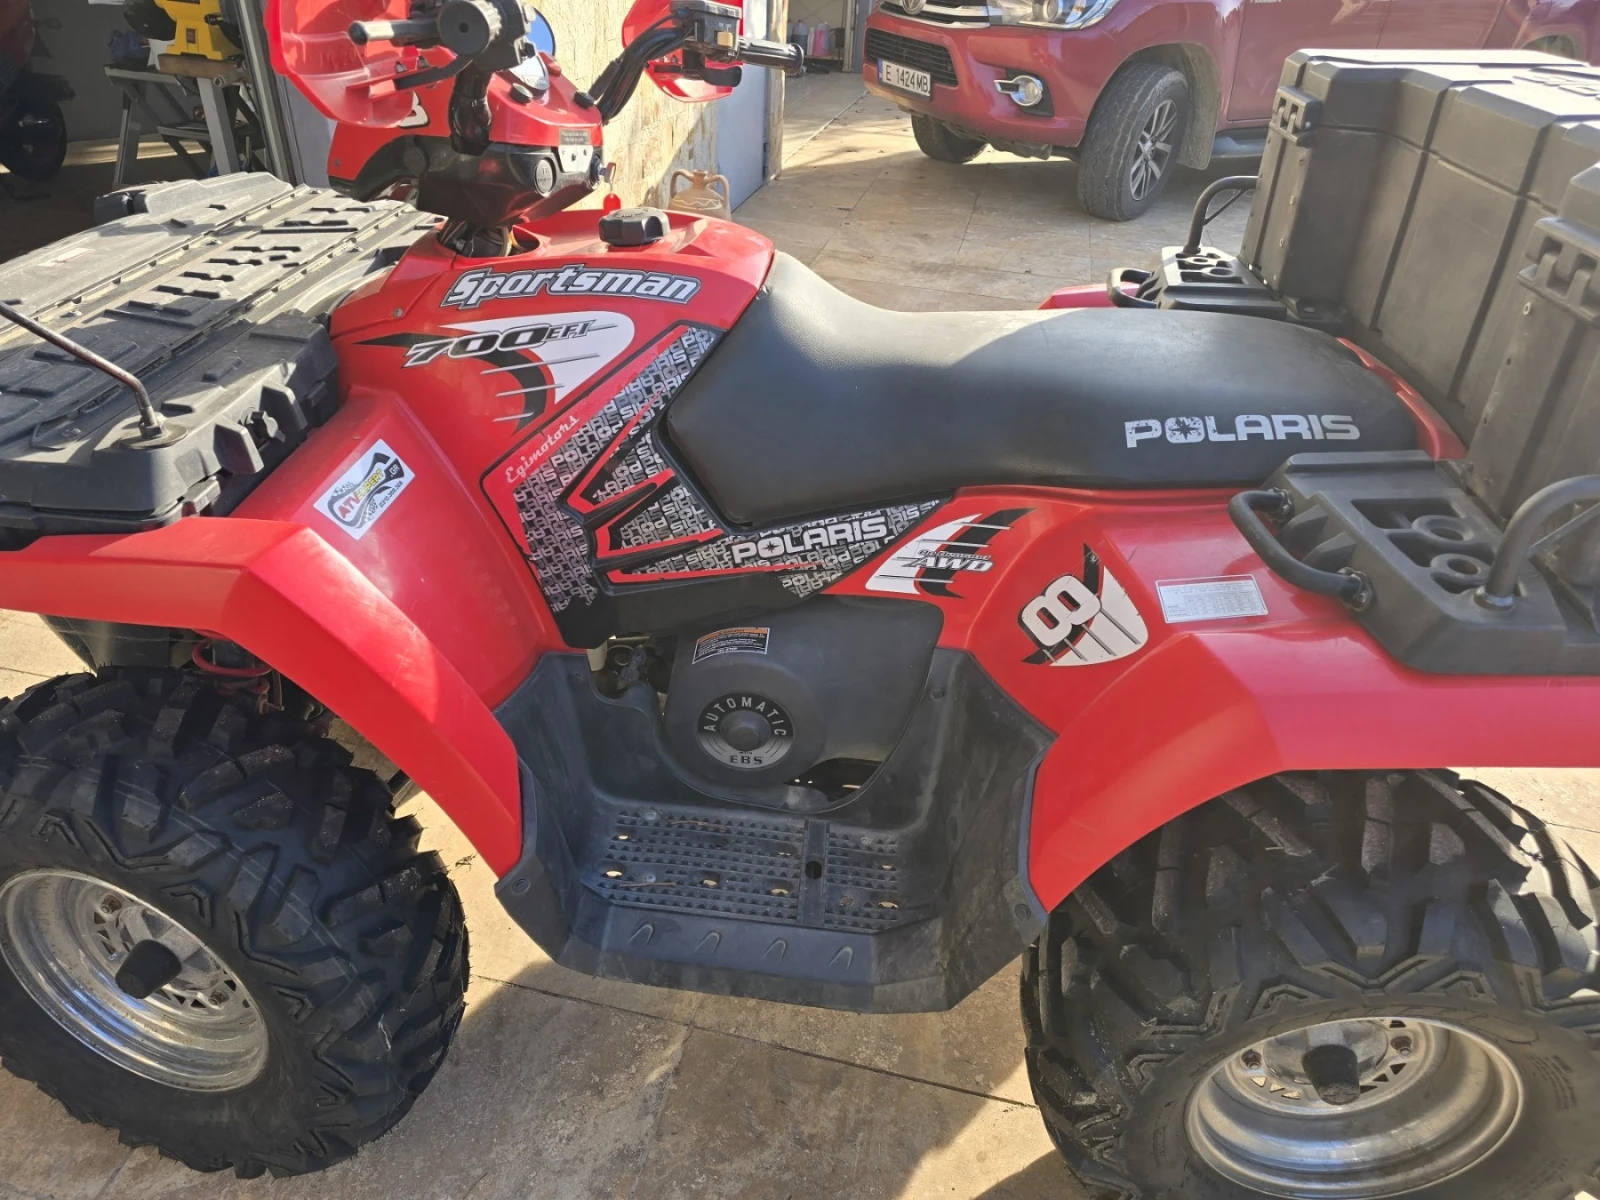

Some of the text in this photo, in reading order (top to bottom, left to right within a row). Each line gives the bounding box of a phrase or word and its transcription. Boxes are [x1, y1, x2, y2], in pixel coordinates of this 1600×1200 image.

[885, 64, 892, 82] E
[441, 264, 700, 309] Sportsman
[505, 415, 579, 484] Egimotors
[1124, 414, 1360, 448] POLARIS
[731, 516, 888, 565] POLARIS
[908, 556, 994, 573] AWD
[1019, 573, 1102, 647] 8
[703, 696, 787, 736] AUTOMATIC
[729, 753, 763, 765] EBS
